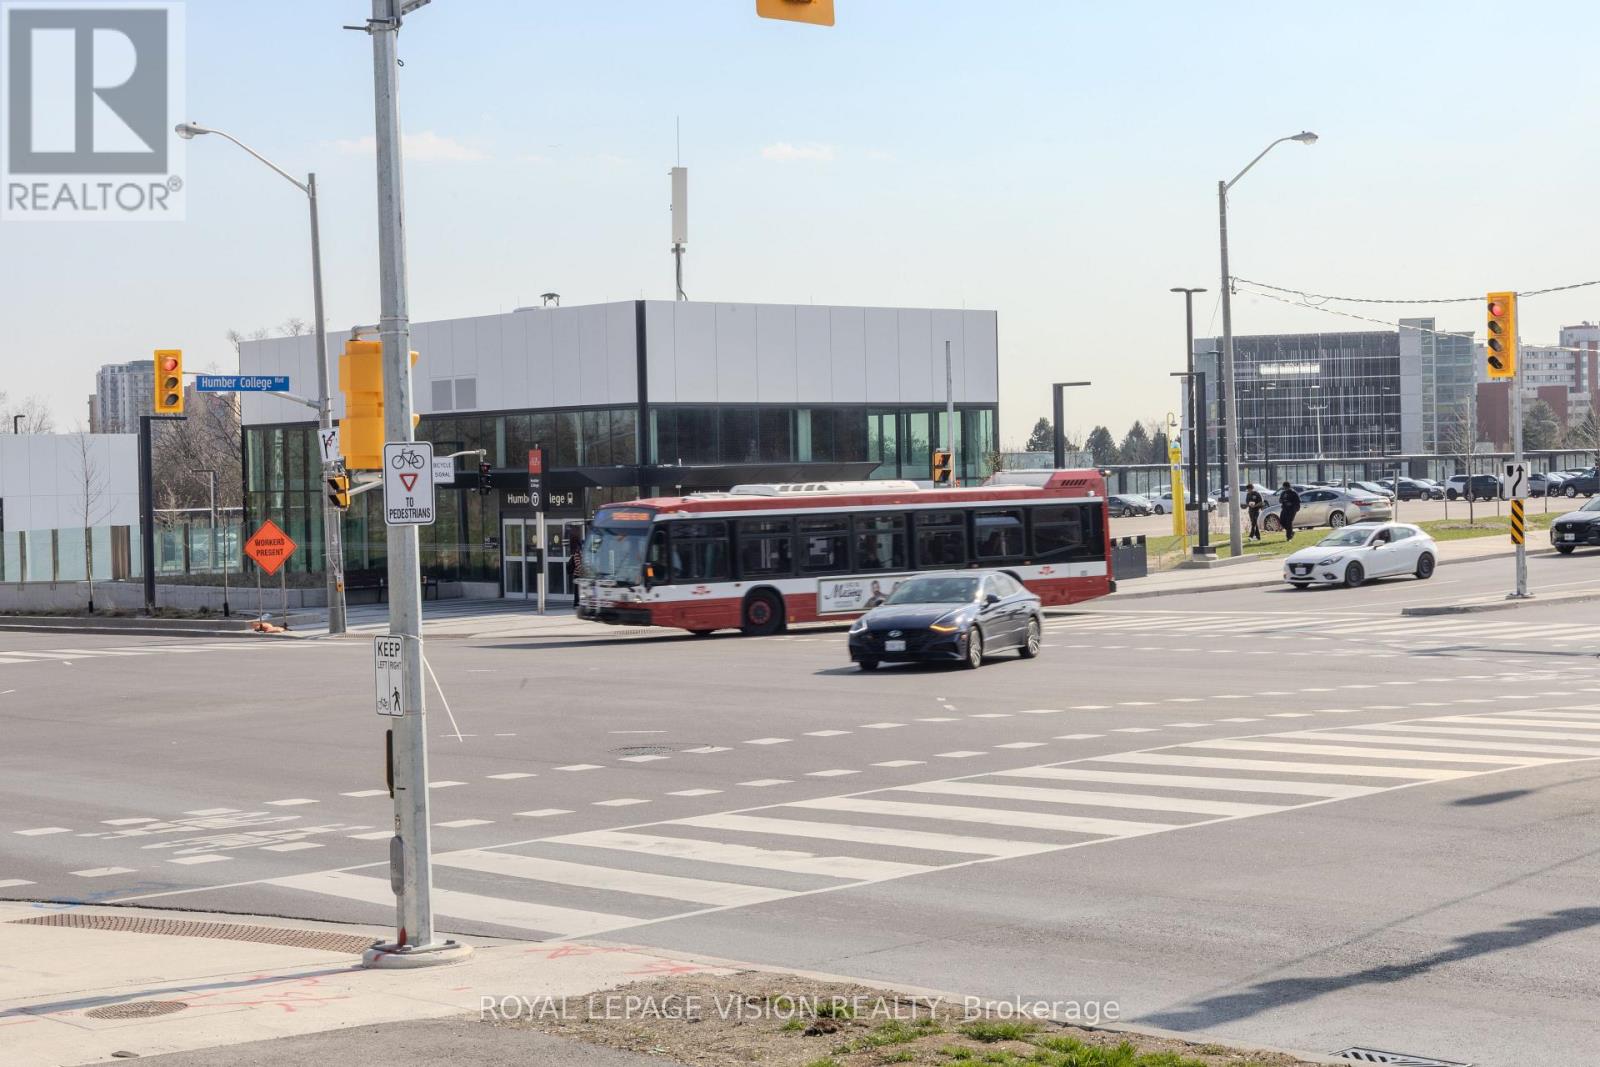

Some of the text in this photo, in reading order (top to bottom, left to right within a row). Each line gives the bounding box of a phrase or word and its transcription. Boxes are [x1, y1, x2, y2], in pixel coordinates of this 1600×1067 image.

[202, 377, 236, 388] Humber
[240, 377, 272, 390] College
[406, 497, 414, 507] TO
[507, 493, 529, 504] Humb
[389, 508, 431, 519] PEDESTRIANS
[255, 538, 285, 546] WORKERS
[377, 642, 400, 657] KEEP
[377, 661, 388, 669] LEFT
